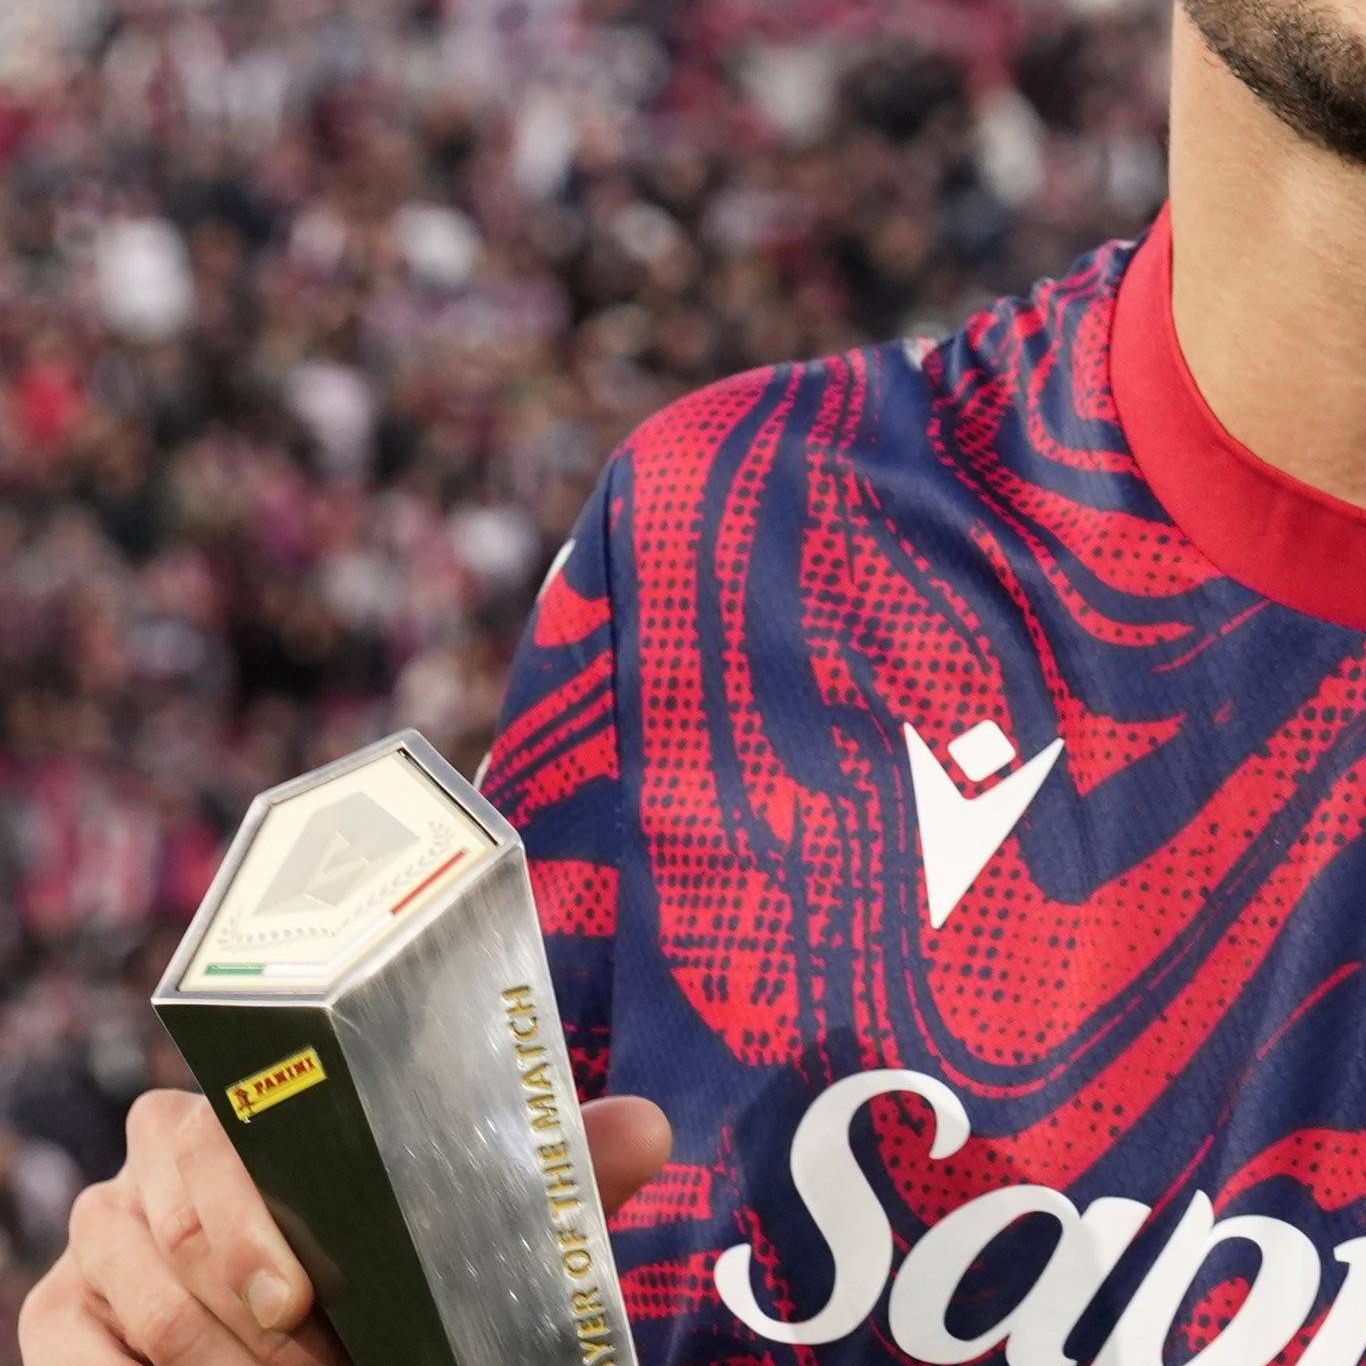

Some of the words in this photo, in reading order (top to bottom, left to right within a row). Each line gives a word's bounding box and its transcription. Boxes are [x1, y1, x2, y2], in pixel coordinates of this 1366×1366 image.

[253, 1056, 315, 1095] PANINI
[501, 985, 561, 1132] MATCH
[537, 1140, 581, 1215] THE
[556, 1227, 592, 1279] OF
